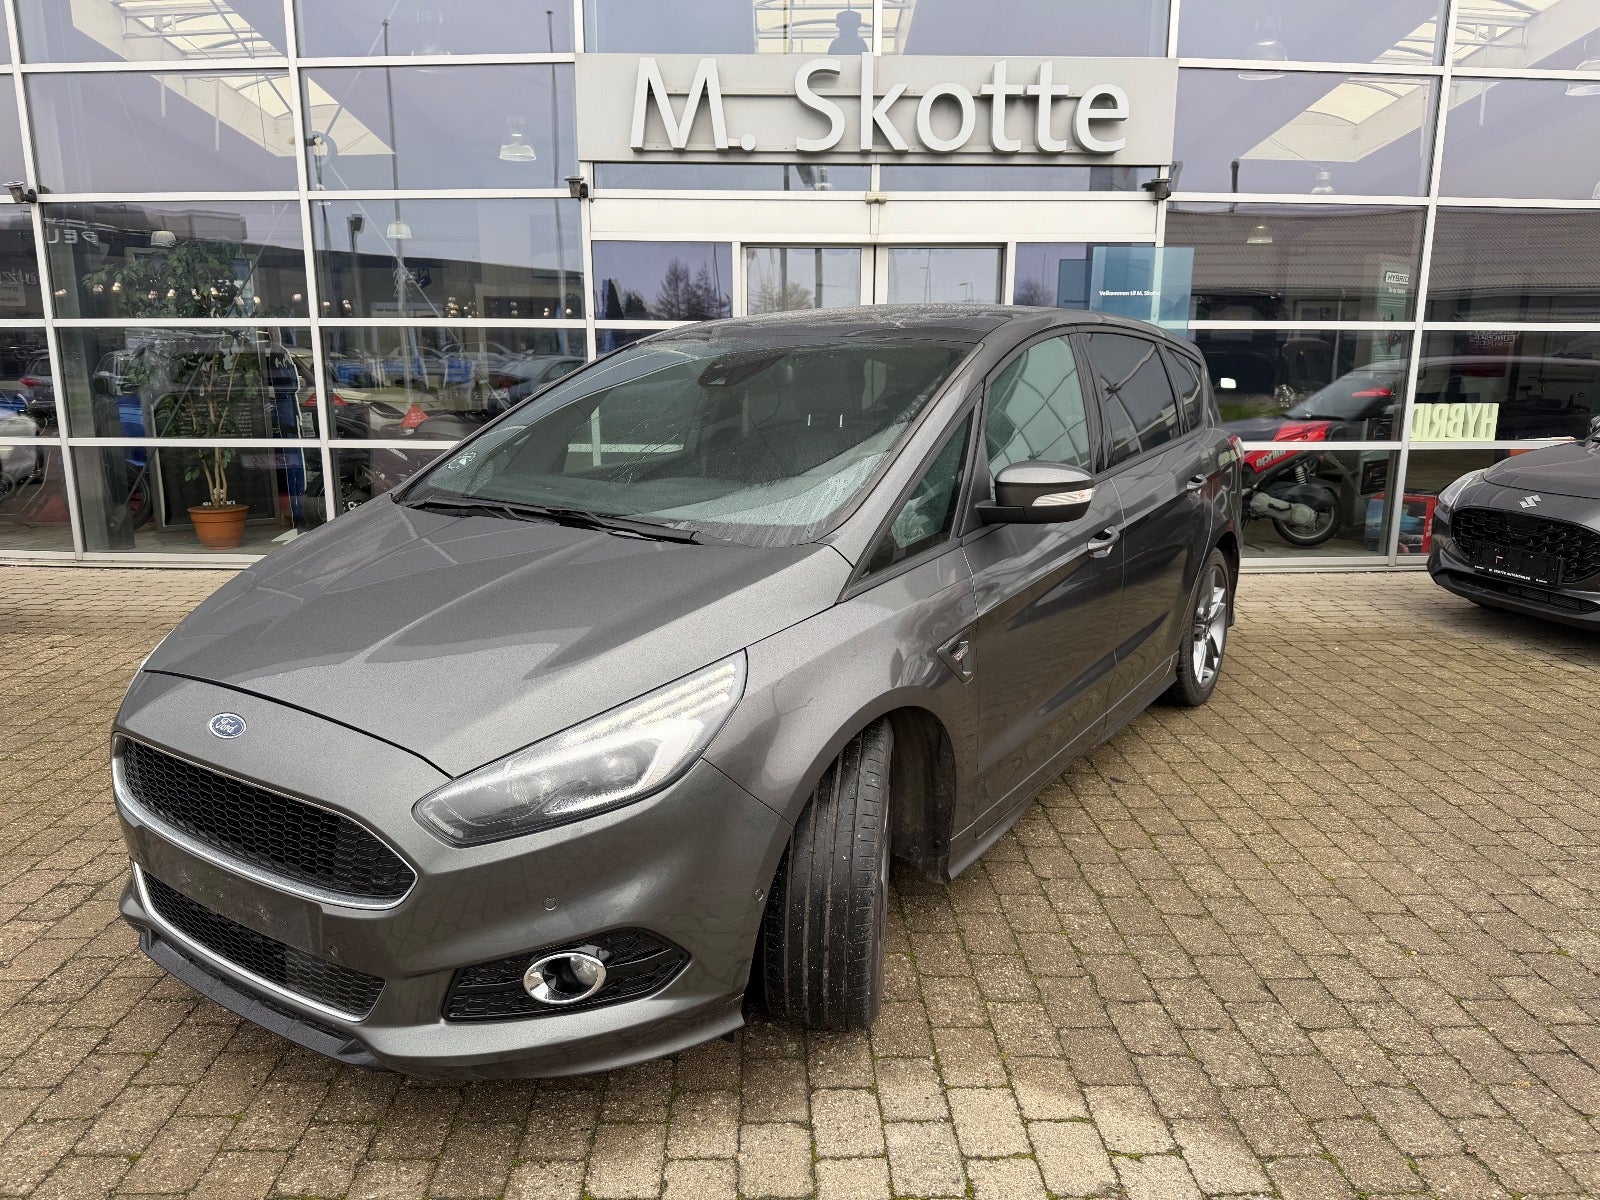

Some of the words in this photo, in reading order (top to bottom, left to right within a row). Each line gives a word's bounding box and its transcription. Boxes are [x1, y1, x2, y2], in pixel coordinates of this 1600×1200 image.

[629, 56, 757, 152] M.
[793, 51, 1130, 155] Skotte
[1387, 273, 1409, 283] HYBRID
[215, 717, 239, 733] Ford
